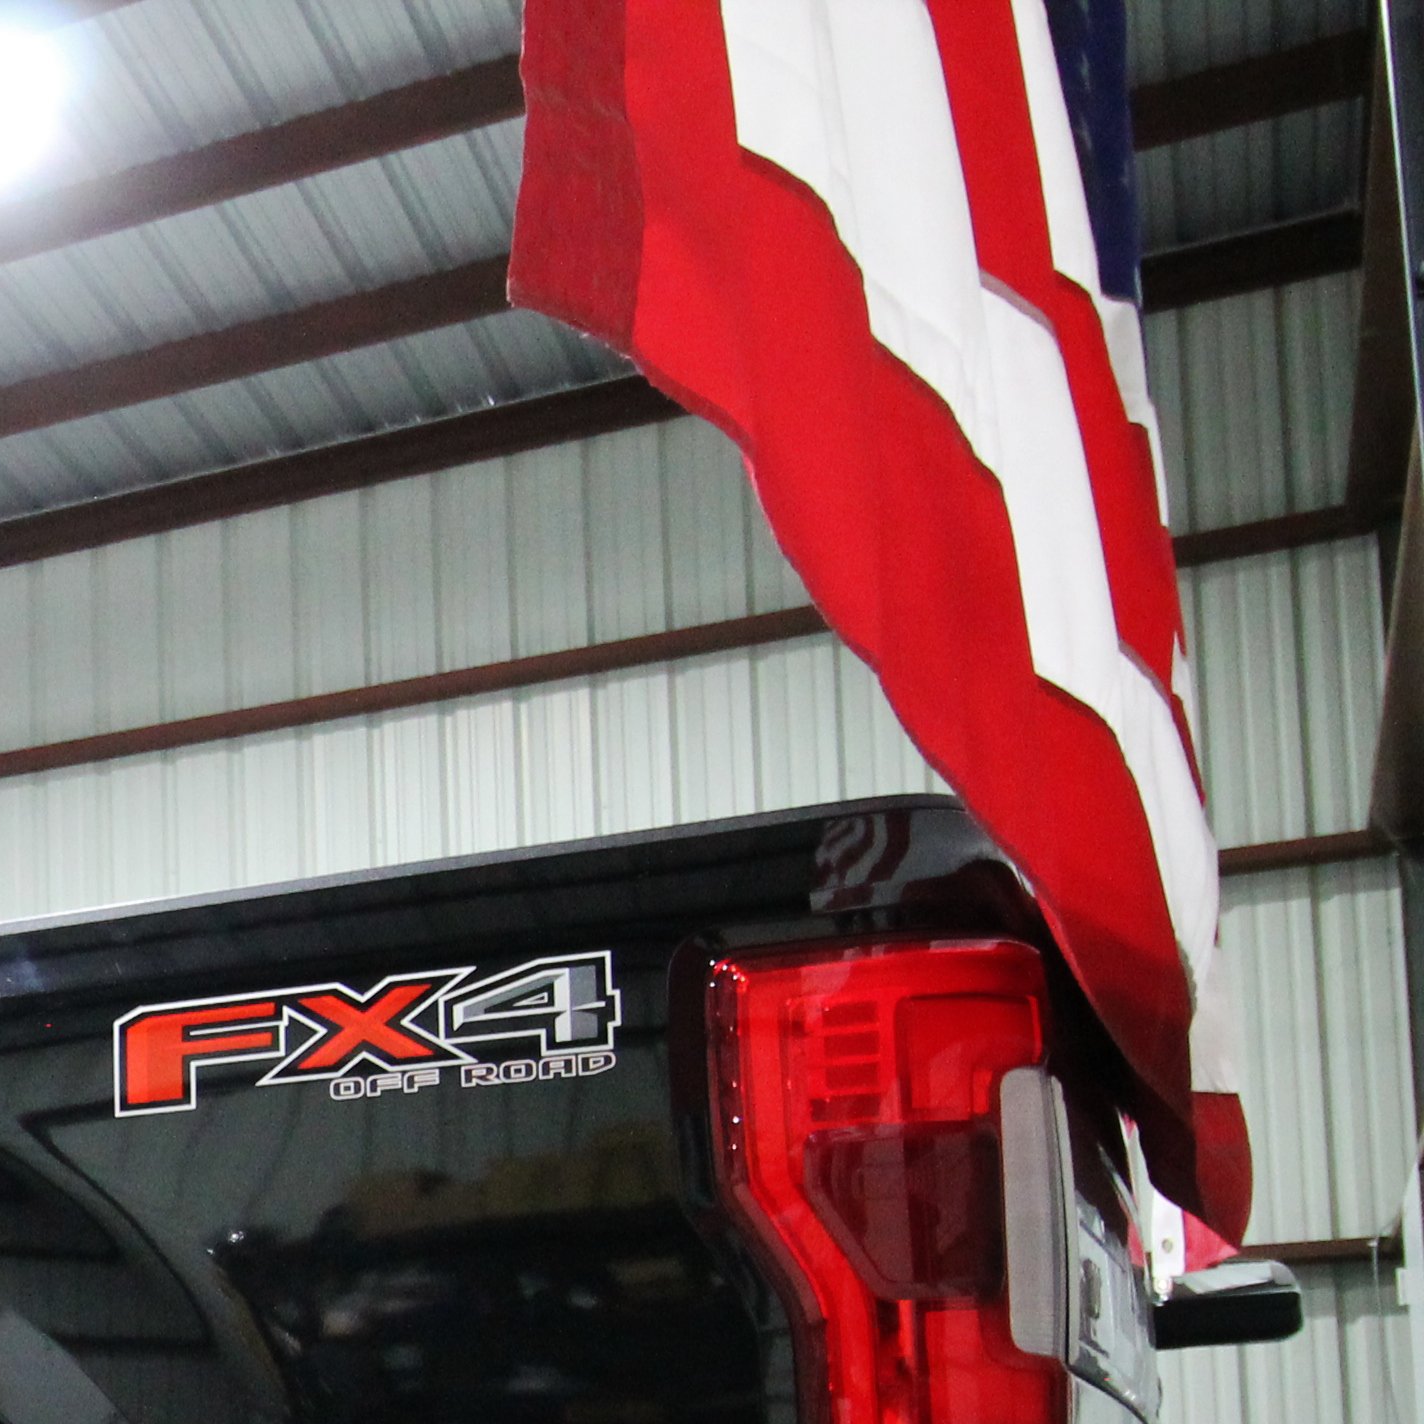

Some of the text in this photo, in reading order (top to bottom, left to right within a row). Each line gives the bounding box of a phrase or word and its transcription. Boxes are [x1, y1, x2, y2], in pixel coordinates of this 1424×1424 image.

[115, 951, 620, 1117] FX4
[330, 1051, 616, 1101] OFF ROAD
